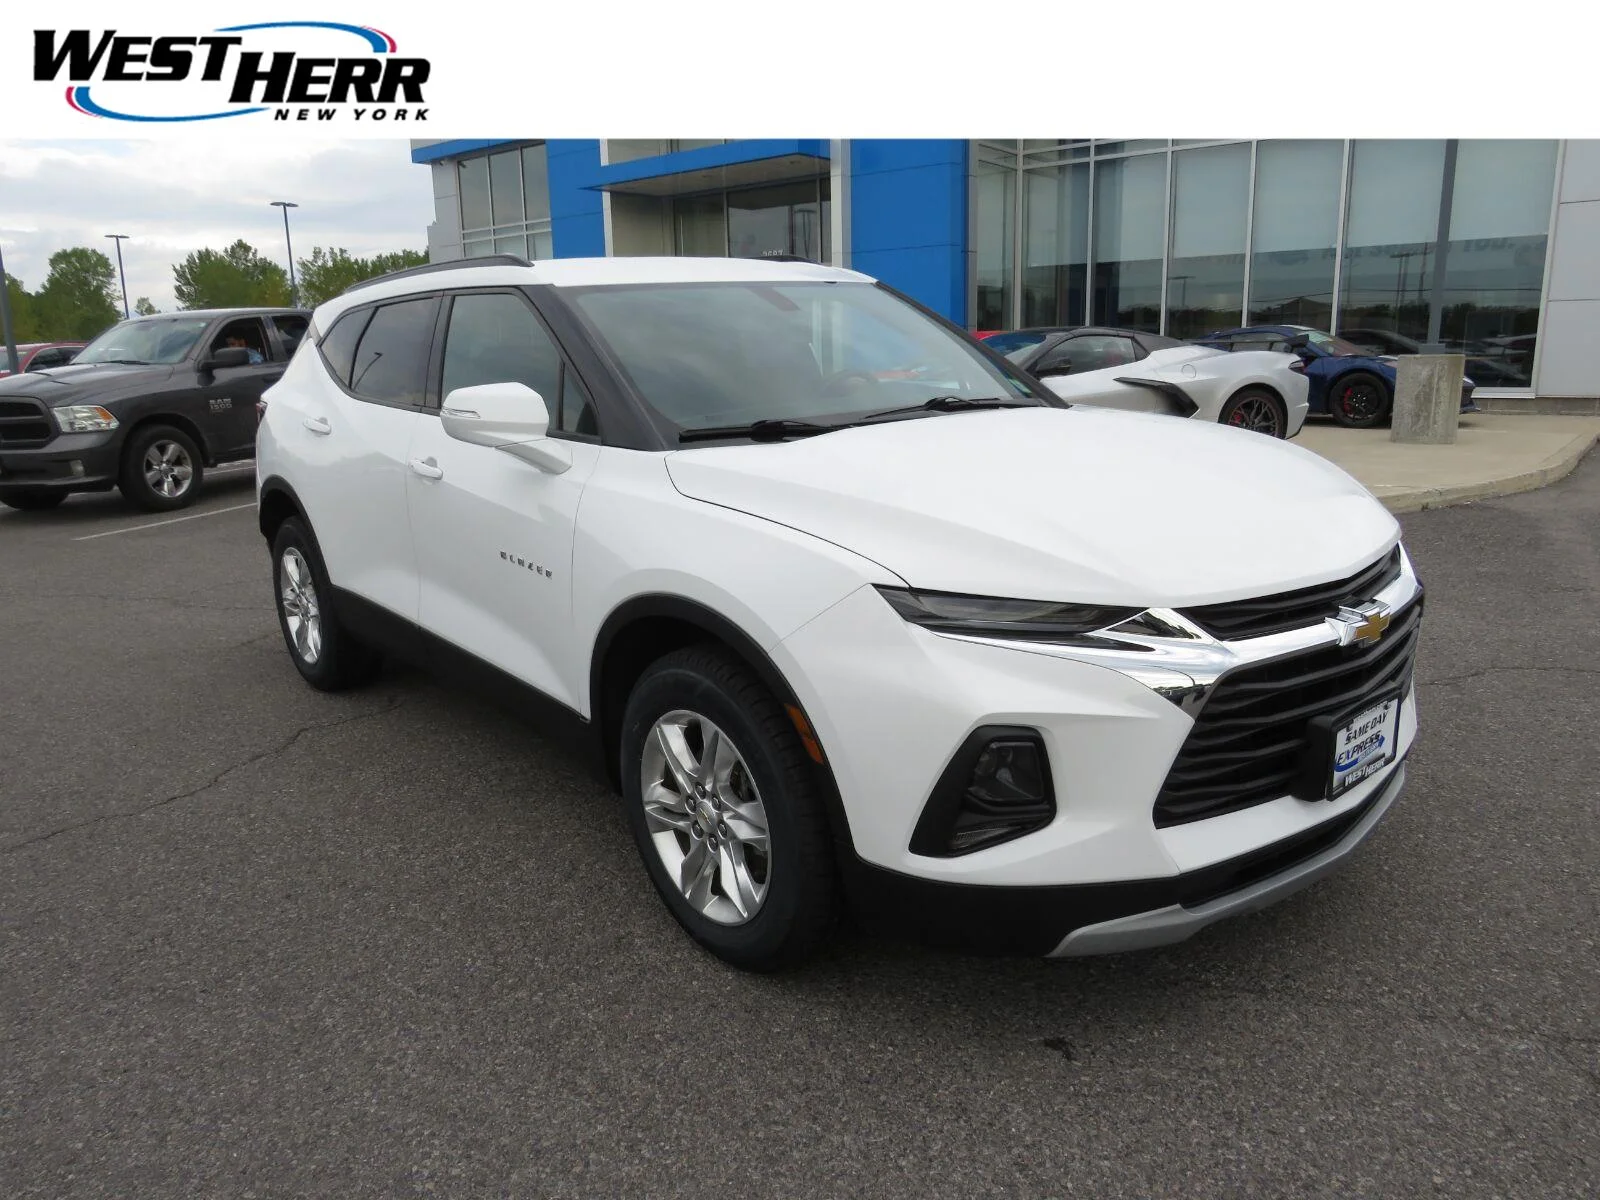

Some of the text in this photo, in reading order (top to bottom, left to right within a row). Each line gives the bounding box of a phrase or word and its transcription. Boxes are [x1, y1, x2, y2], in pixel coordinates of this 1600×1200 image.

[500, 551, 553, 579] BLAZER
[1344, 710, 1389, 745] SAME DAY
[1337, 730, 1382, 765] EXPRESS
